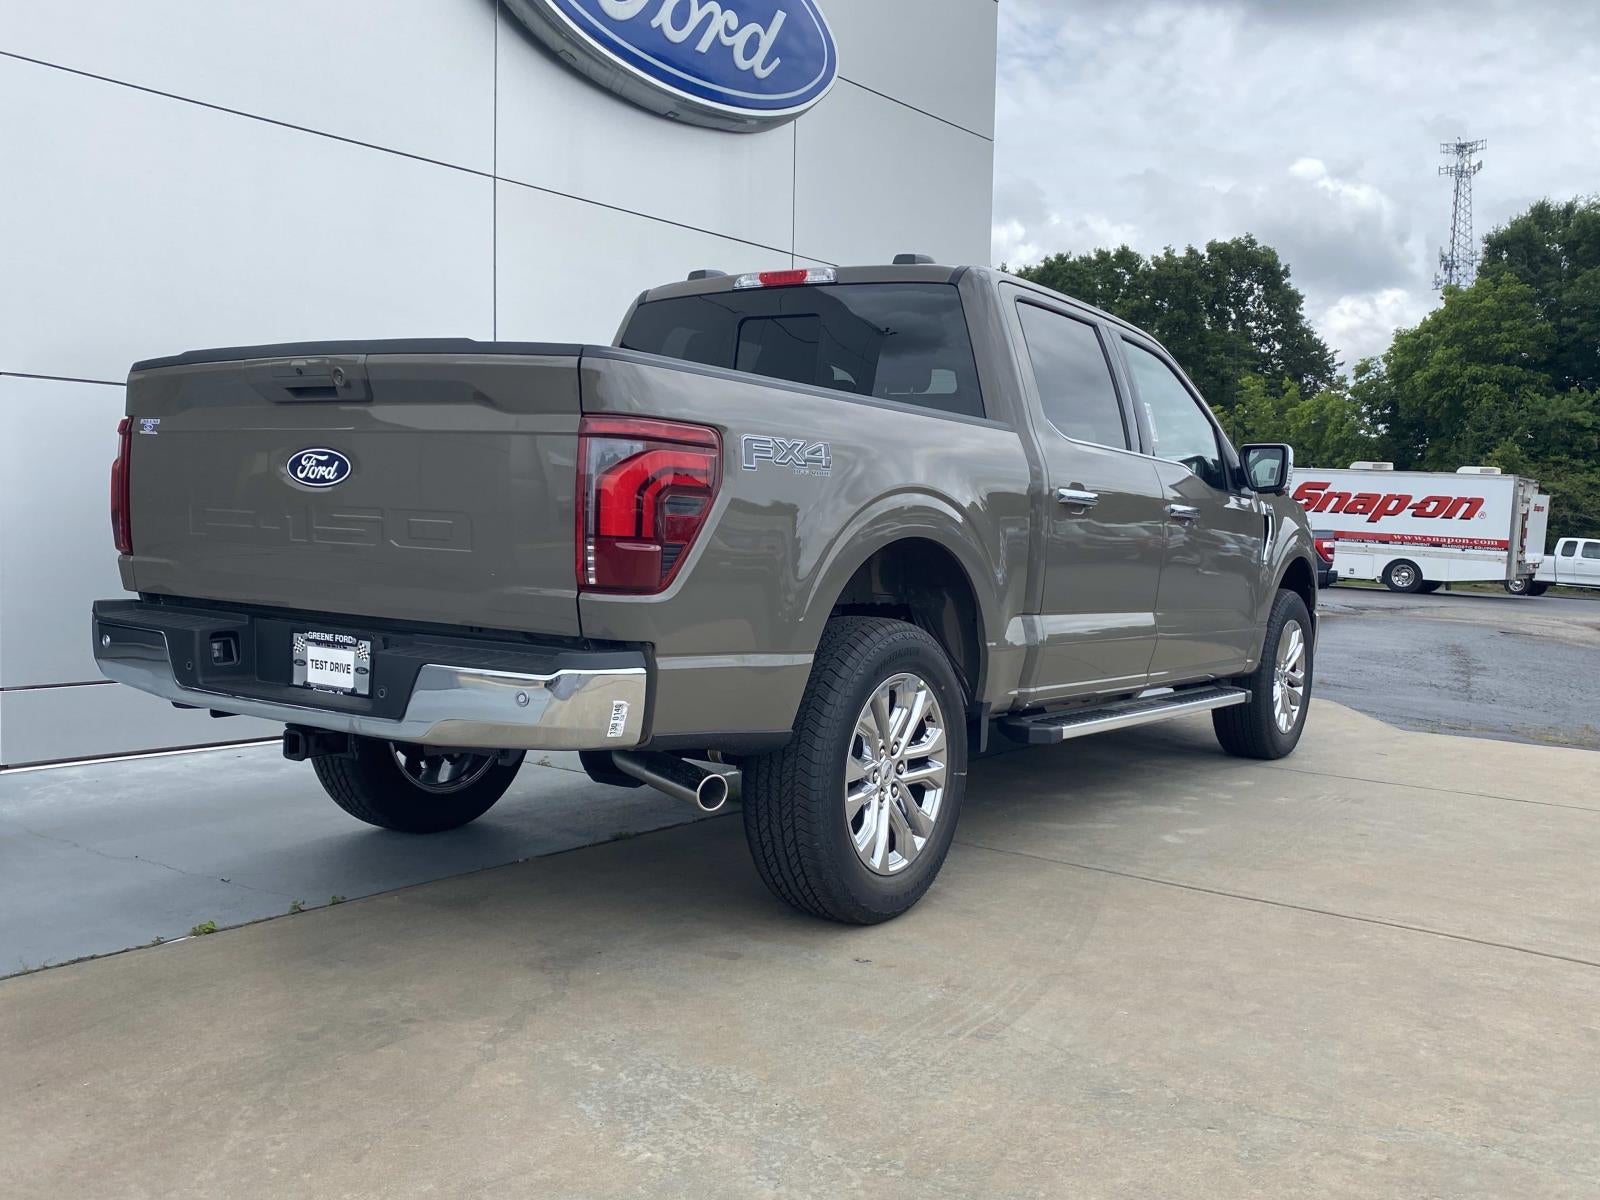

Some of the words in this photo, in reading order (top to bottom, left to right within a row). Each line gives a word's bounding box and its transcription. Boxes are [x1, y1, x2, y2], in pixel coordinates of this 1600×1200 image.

[600, 0, 787, 79] ord
[297, 453, 339, 480] Ford
[741, 433, 832, 471] FX4
[1292, 481, 1485, 523] Snap-on
[308, 631, 334, 642] GREENE
[335, 634, 354, 644] FORD
[310, 659, 328, 671] TEST
[329, 661, 351, 674] DRIVE
